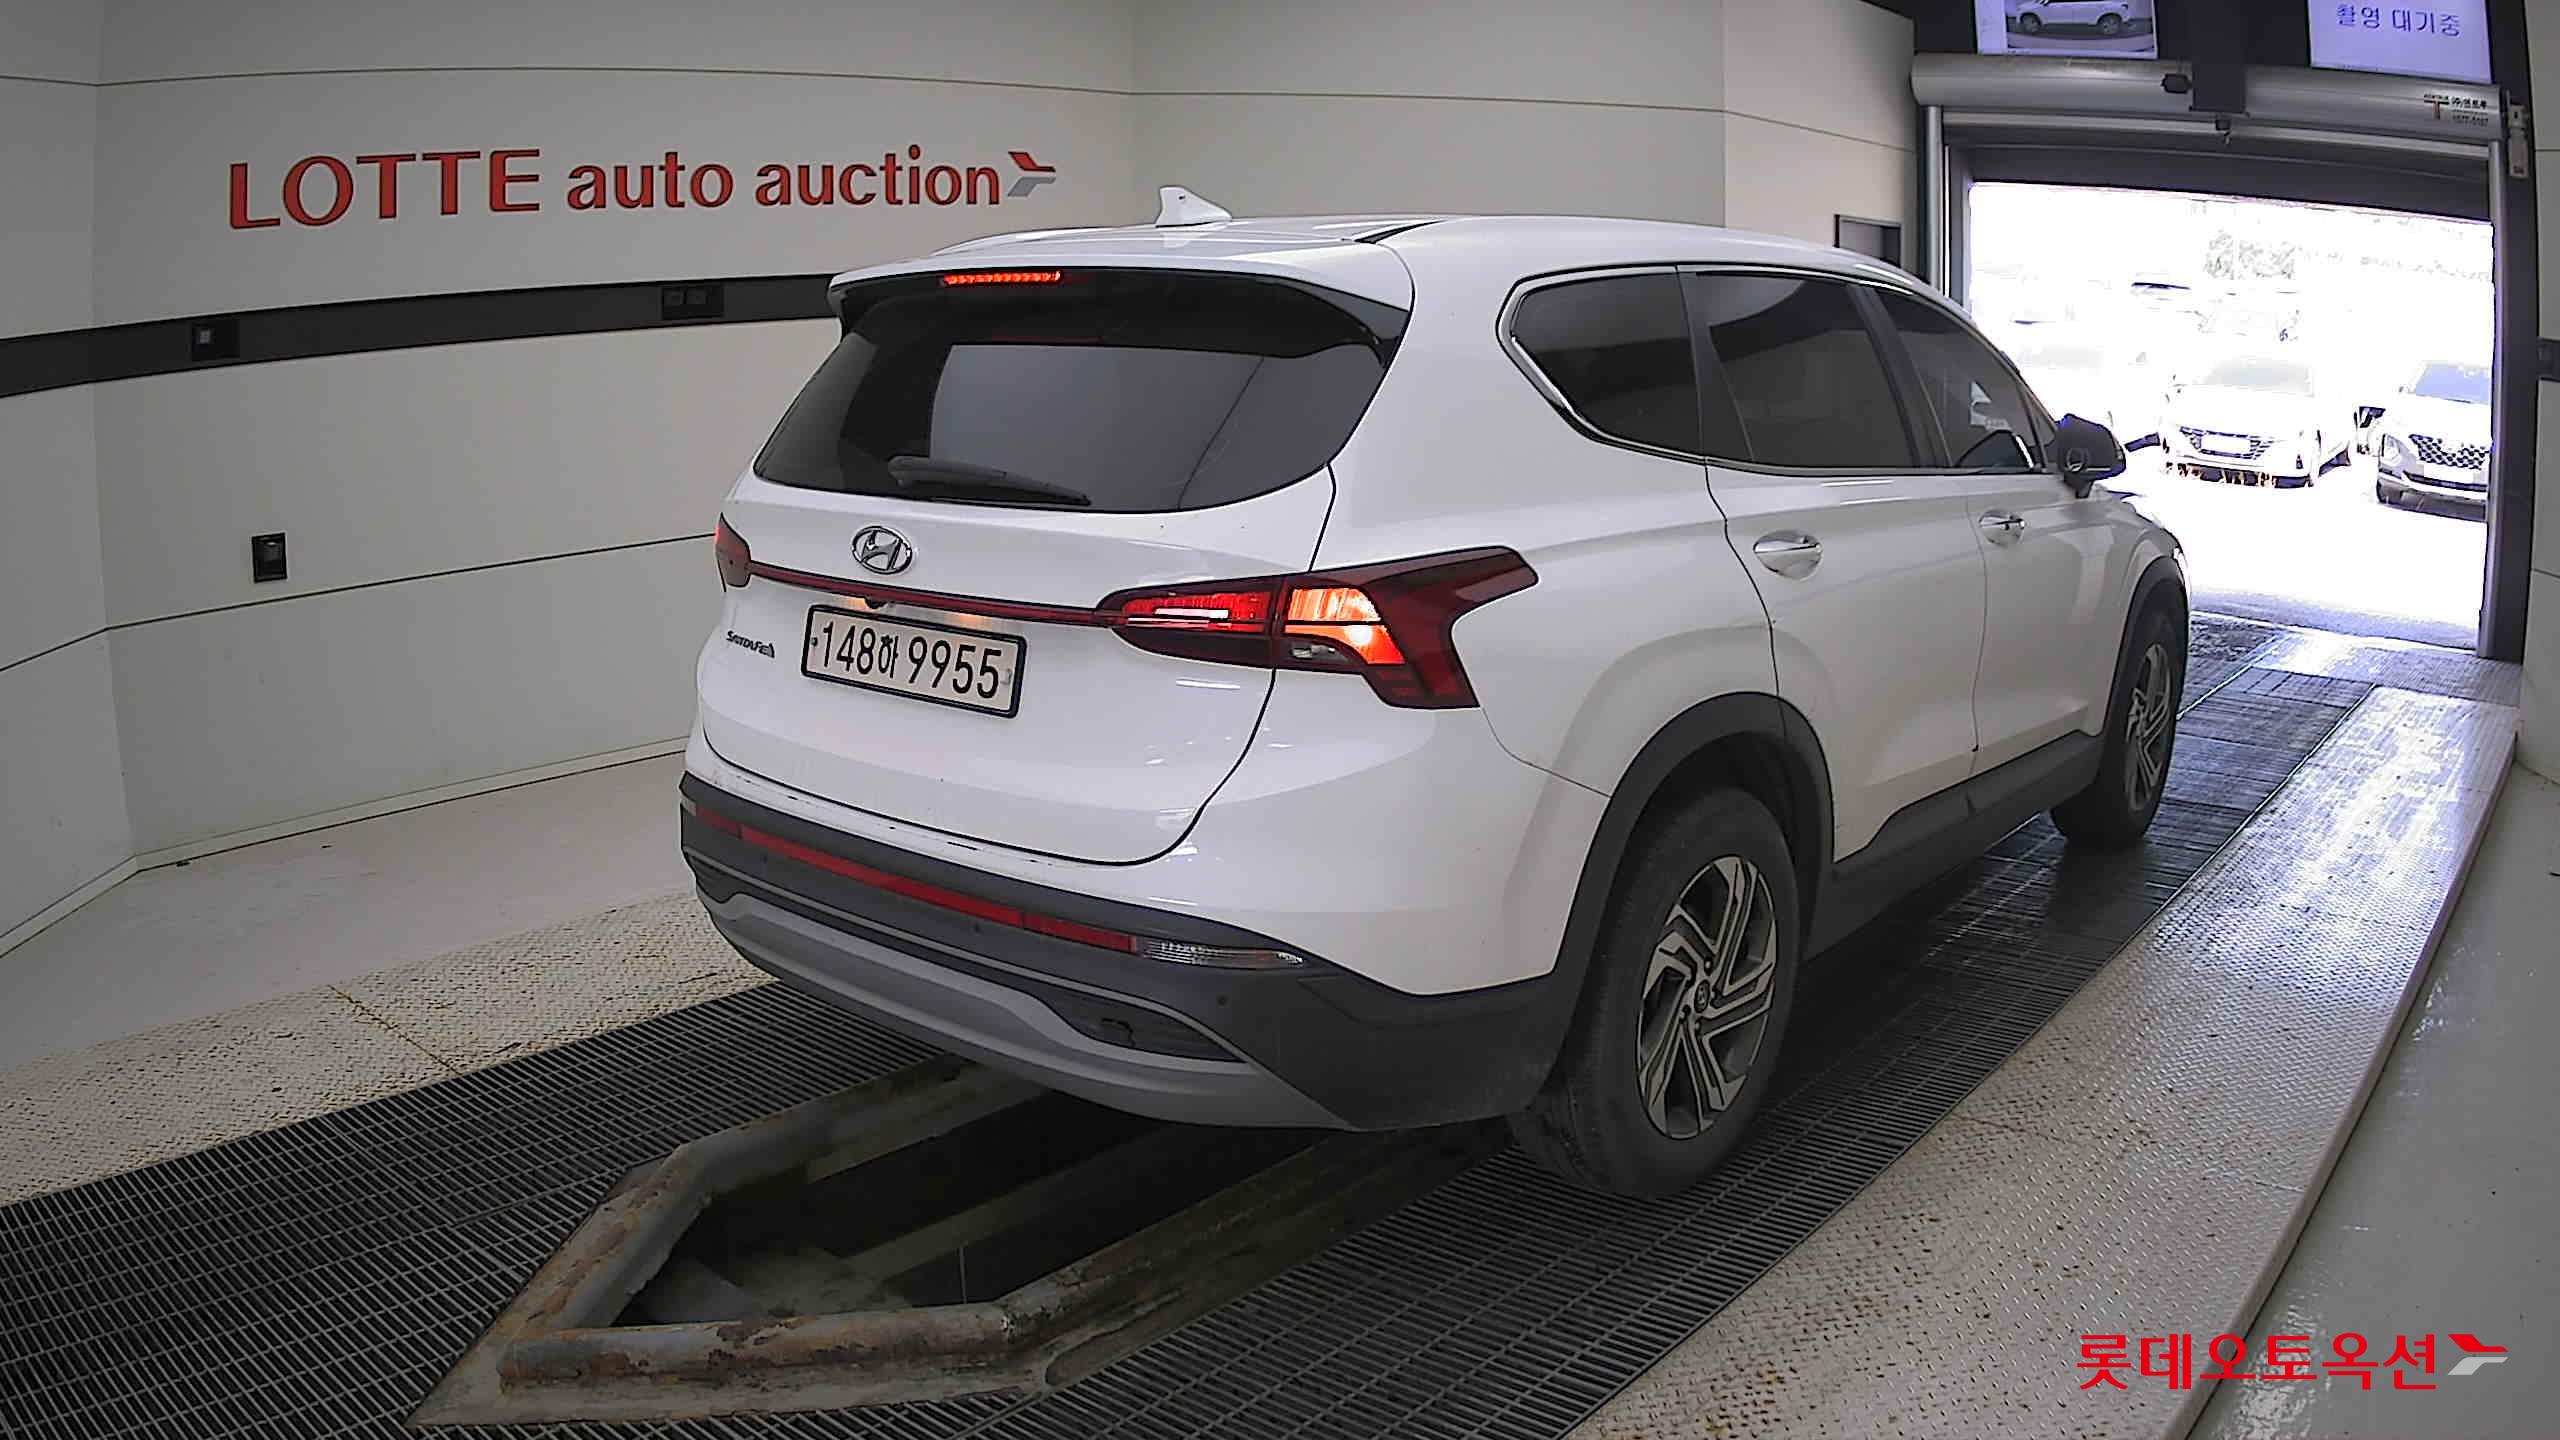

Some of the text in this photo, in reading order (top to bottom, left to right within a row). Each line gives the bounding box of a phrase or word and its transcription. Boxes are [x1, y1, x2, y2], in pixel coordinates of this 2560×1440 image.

[2336, 4, 2460, 37] 촬영 대기중
[229, 144, 1001, 230] LOTTE auto auction
[823, 621, 1002, 698] 148하 9955
